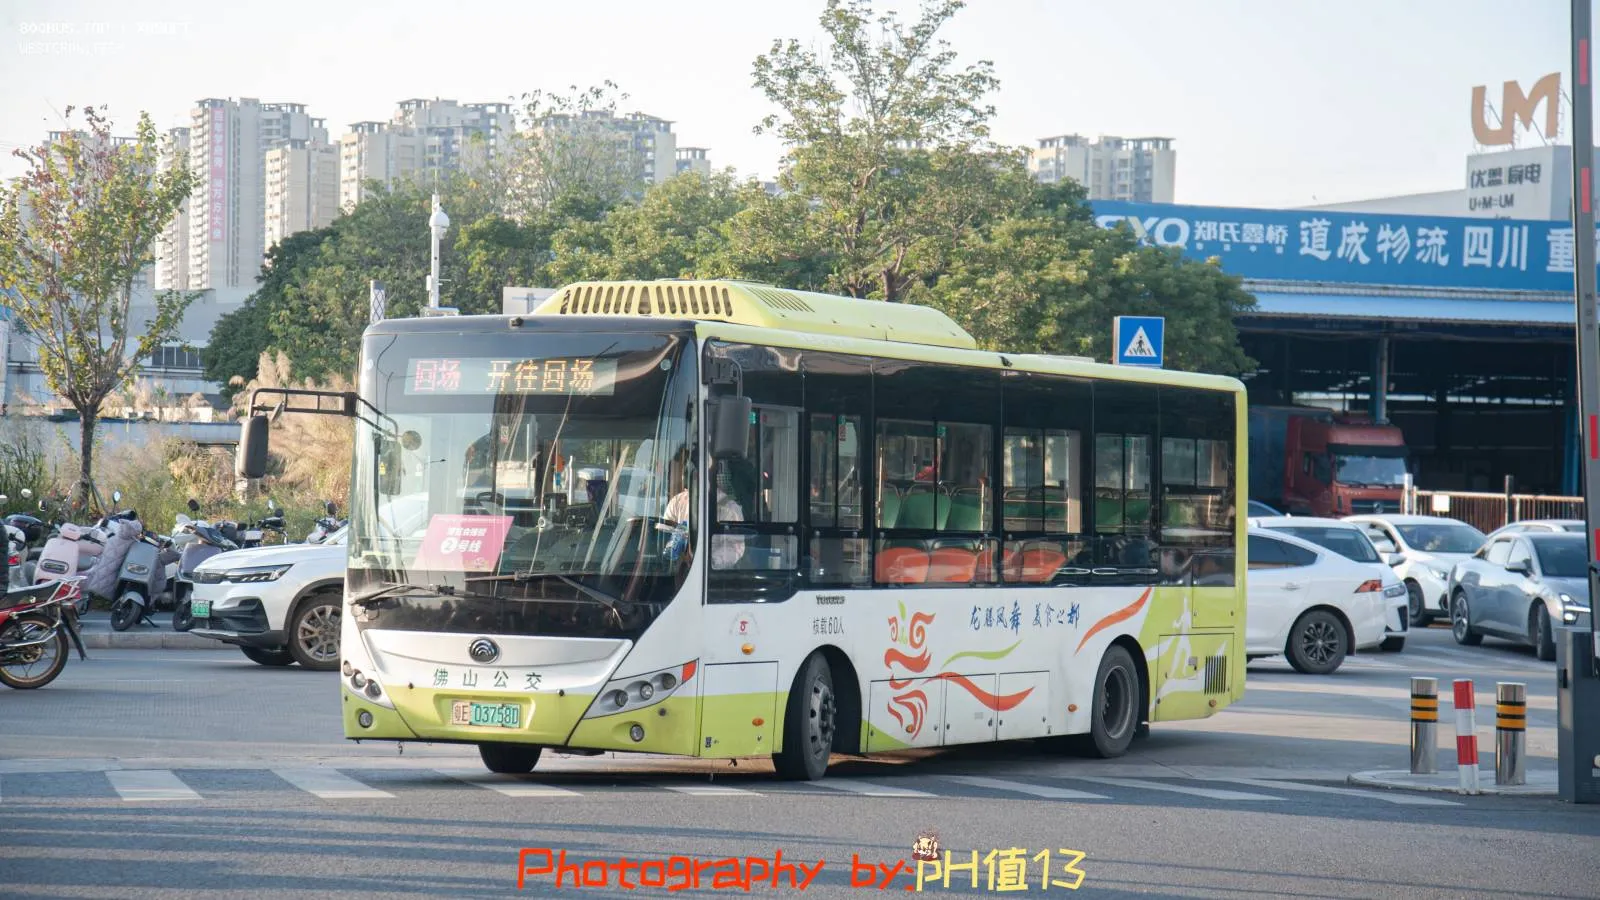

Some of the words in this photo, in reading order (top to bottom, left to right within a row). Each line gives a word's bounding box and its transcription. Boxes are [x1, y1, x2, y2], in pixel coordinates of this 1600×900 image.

[1300, 217, 1449, 267] 道成物流
[1462, 225, 1529, 272] 四川
[415, 359, 461, 392] 回场
[485, 359, 595, 392] 开往回场
[433, 667, 543, 691] 佛山公交
